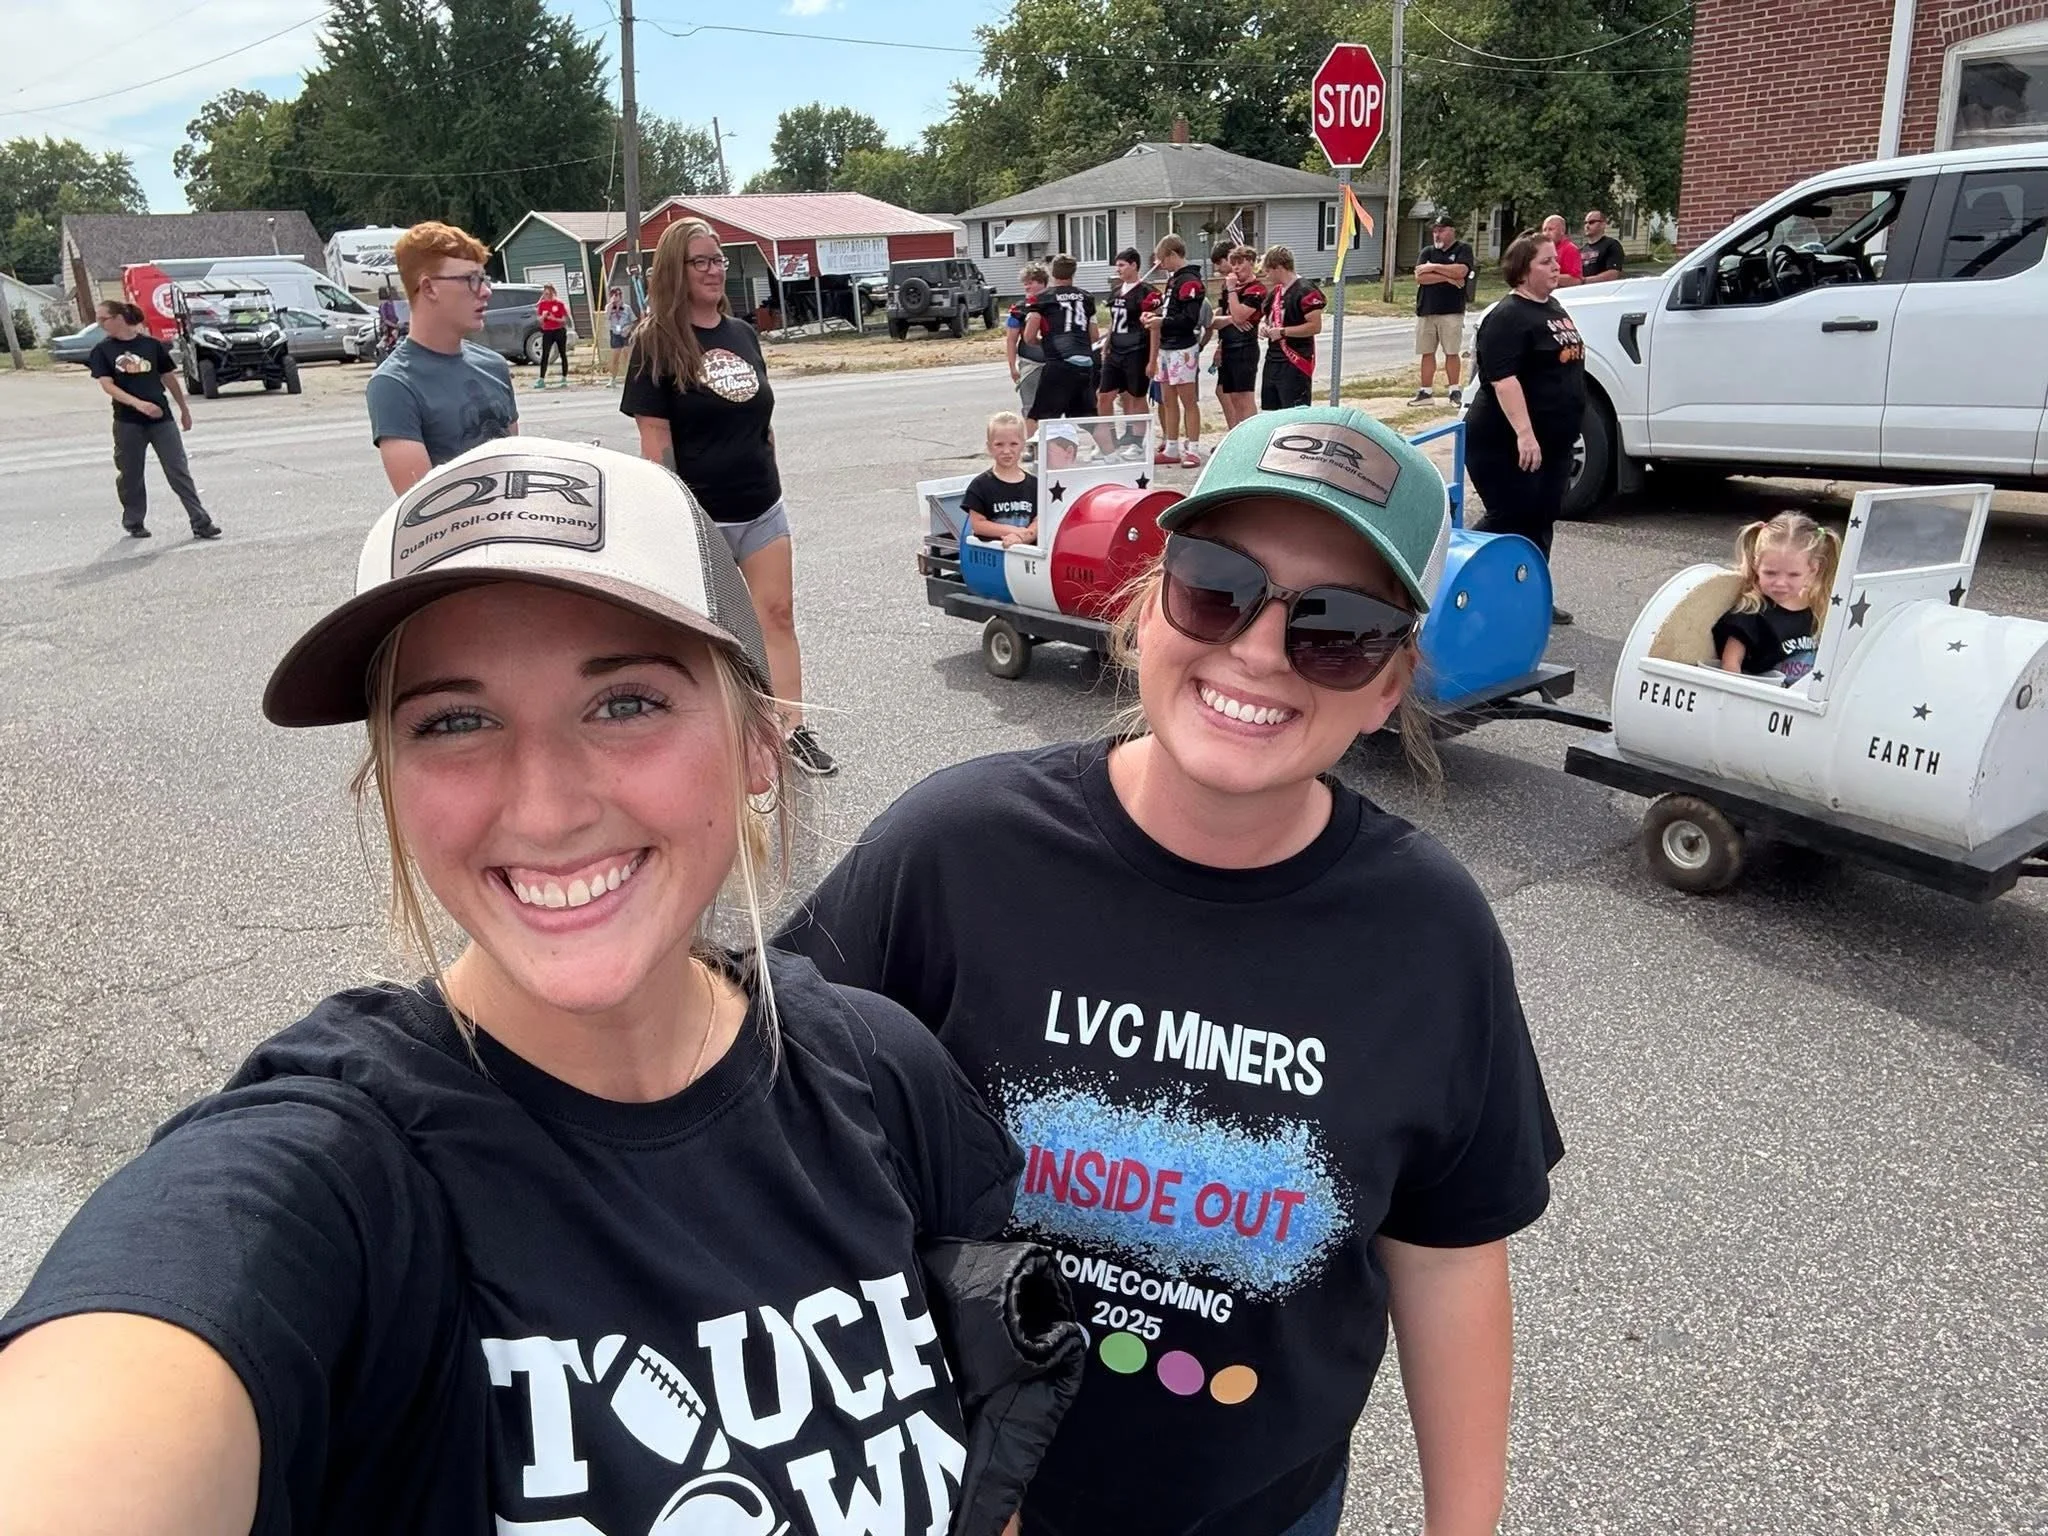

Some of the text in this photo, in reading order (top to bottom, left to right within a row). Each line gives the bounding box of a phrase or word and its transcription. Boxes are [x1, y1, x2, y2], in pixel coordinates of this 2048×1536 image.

[1318, 83, 1381, 128] STOP
[1060, 301, 1088, 332] 74
[1111, 307, 1128, 333] 72
[1300, 454, 1388, 494] Quality Roll-Off Company
[994, 501, 1010, 513] LVC
[400, 511, 598, 560] Quality Roll-Off Company
[1024, 560, 1036, 575] WE
[1639, 681, 1941, 775] PEACE ON EARTH
[1044, 990, 1326, 1096] LVC MINERS
[1023, 1145, 1306, 1243] INSIDE OUT
[1091, 1301, 1163, 1340] 2025
